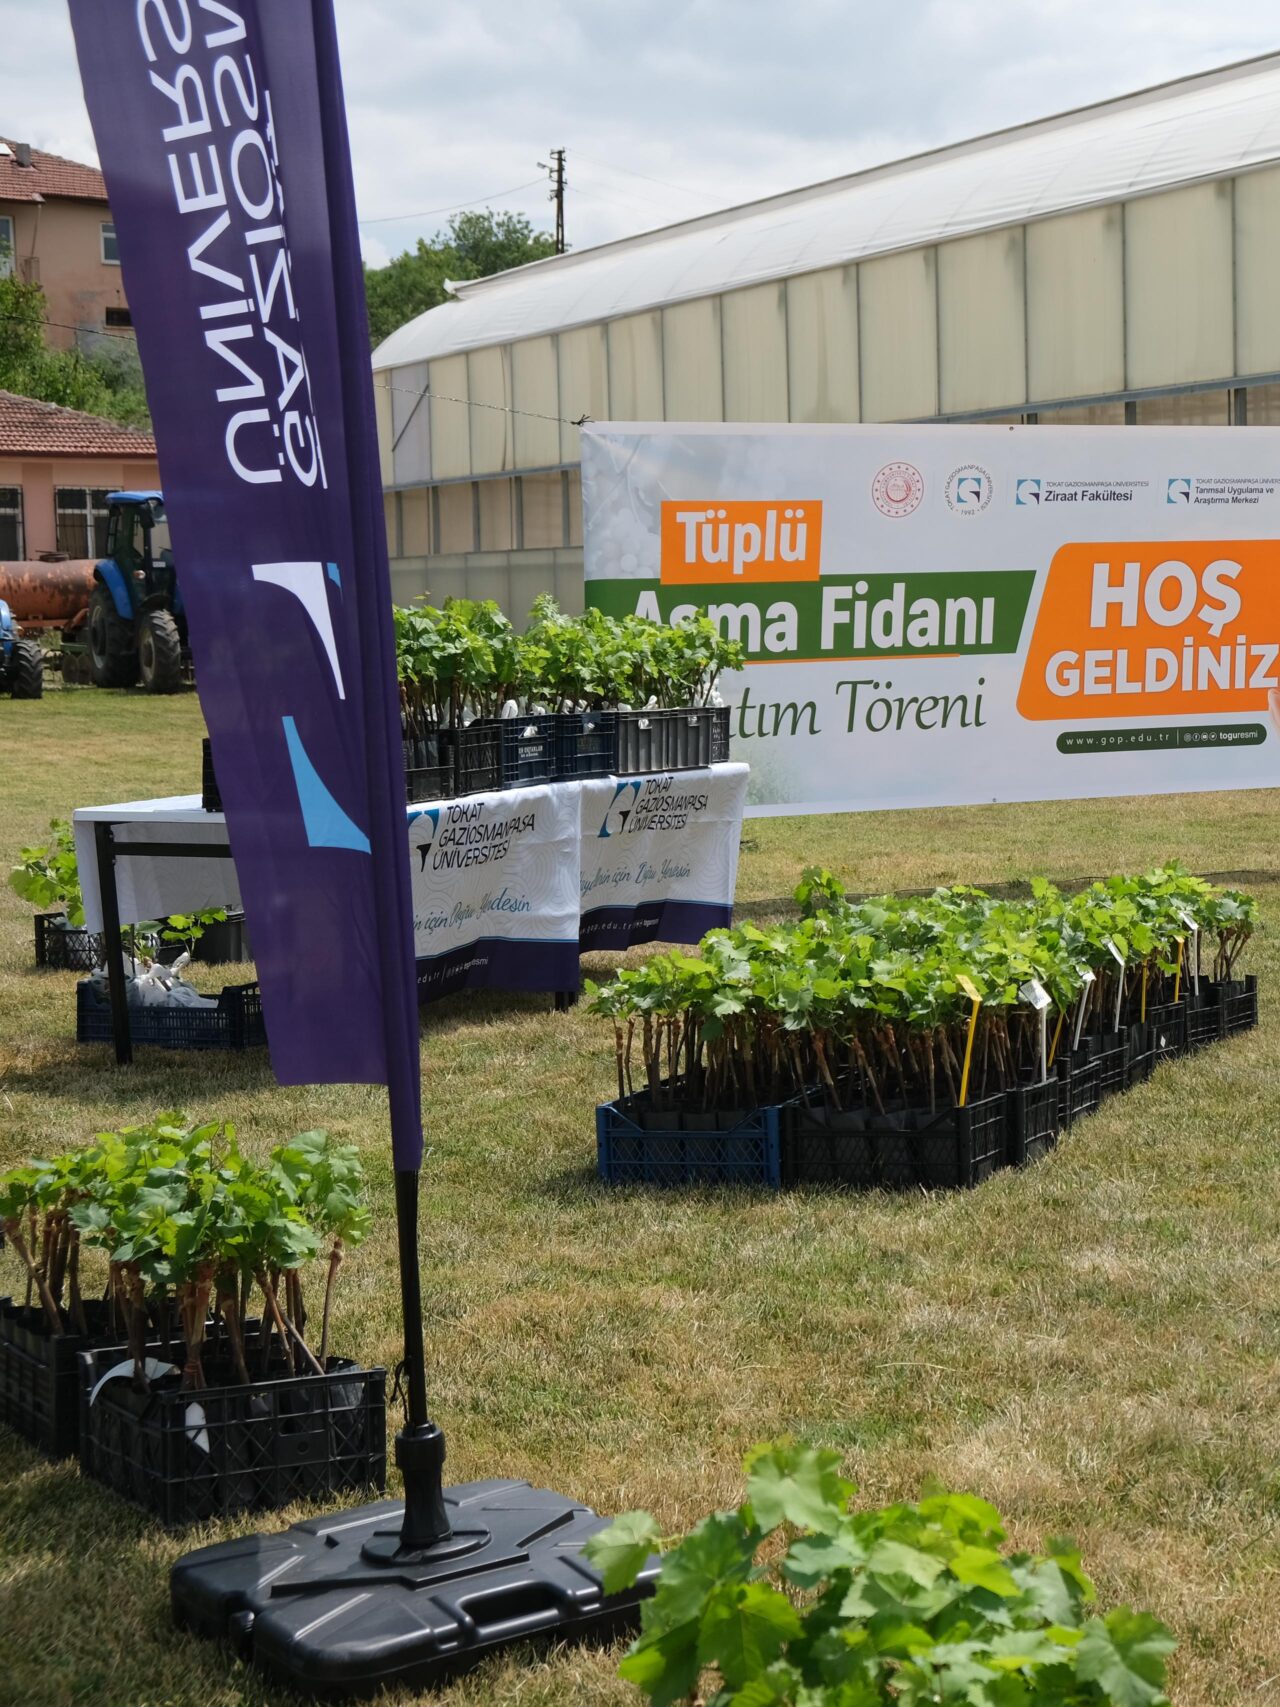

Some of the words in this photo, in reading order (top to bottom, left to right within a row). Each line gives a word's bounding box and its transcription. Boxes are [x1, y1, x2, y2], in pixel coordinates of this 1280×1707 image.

[1044, 490, 1078, 502] Ziraat
[1081, 490, 1133, 502] Fakültesi
[1194, 497, 1230, 505] Araştırma
[1231, 496, 1260, 504] Merkezi
[1227, 486, 1264, 496] Uygulama
[676, 509, 808, 575] Tüplü
[1090, 559, 1243, 638] HOŞ
[820, 580, 995, 650] Fidanı
[1045, 634, 1280, 697] GELDİNİZ
[836, 677, 987, 733] Töreni
[1066, 733, 1170, 746] www.gop.edu.tr
[1219, 729, 1258, 740] toguresmi
[645, 776, 674, 795] TOKAT
[446, 803, 485, 825] TOKAT
[432, 837, 512, 870] ÜNİVERSİTESİ
[424, 911, 448, 934] için
